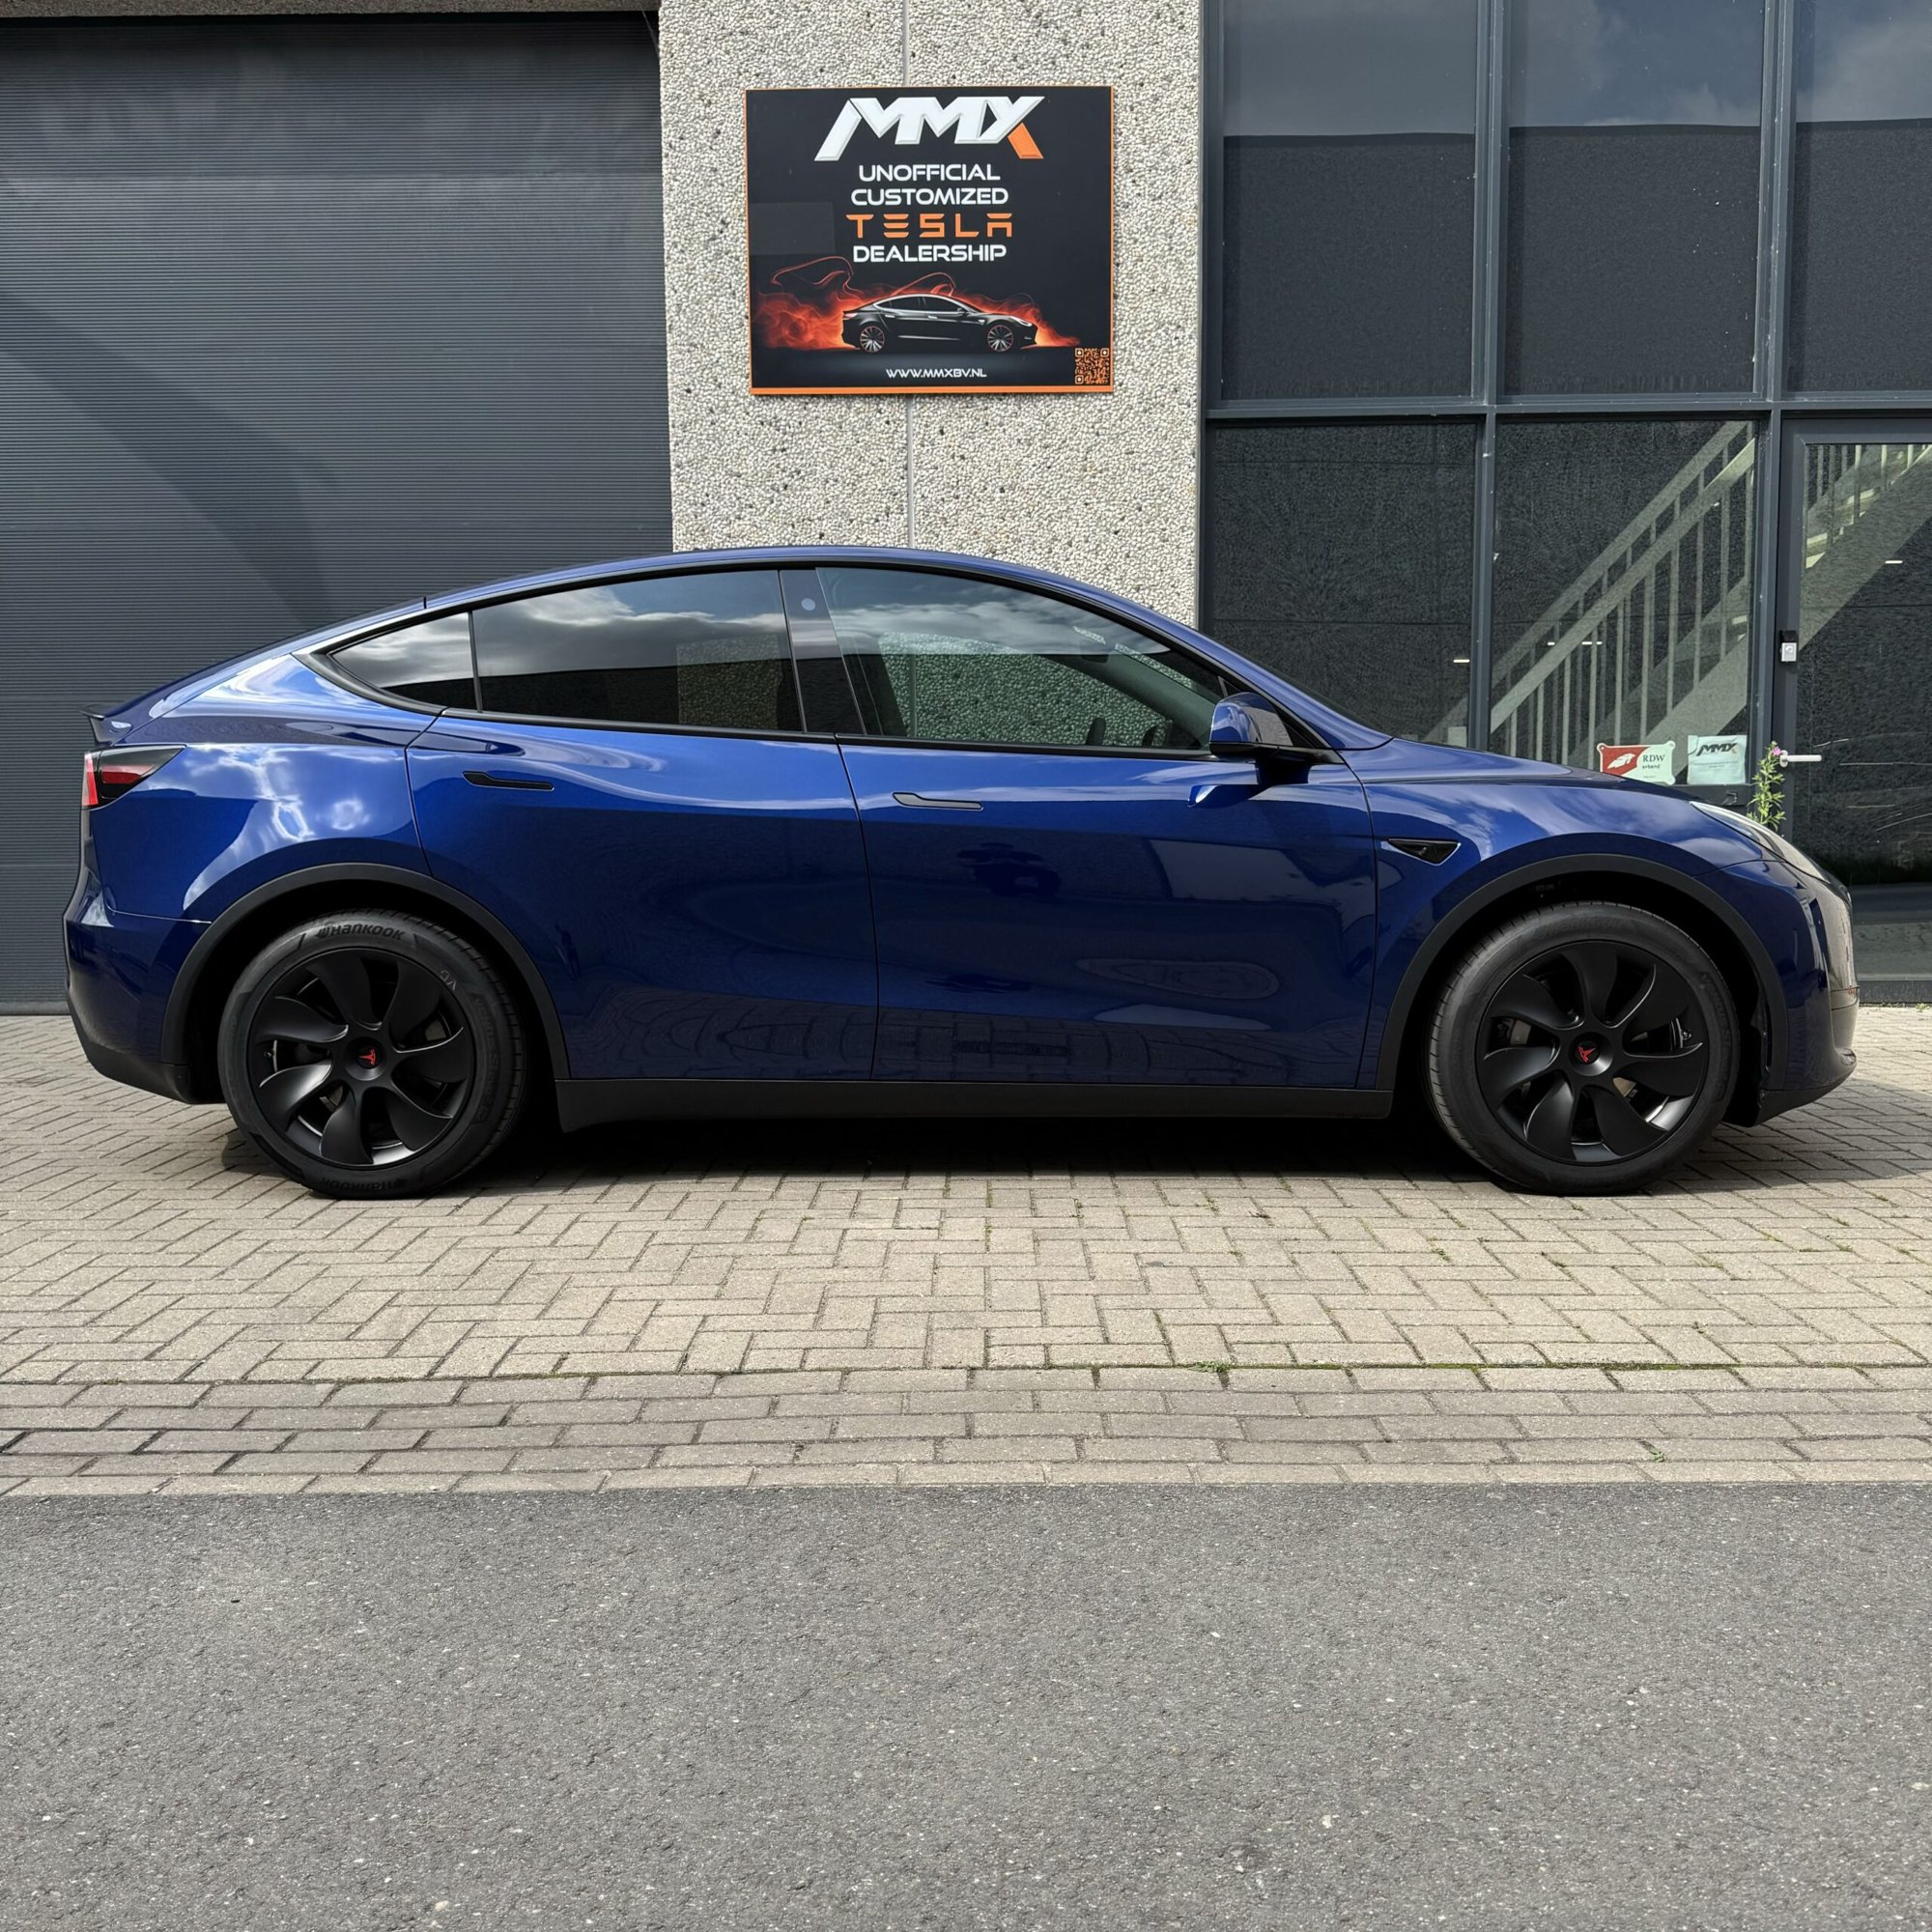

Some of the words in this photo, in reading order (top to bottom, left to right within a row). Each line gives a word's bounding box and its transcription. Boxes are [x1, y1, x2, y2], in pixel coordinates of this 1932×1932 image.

[813, 96, 1045, 162] MMX
[858, 163, 1002, 183] UNOFFICIAL
[850, 186, 1009, 207] CUSTOMIZED
[845, 213, 1013, 239] TESLA
[852, 243, 1008, 264] DEALERSHIP
[885, 367, 988, 380] WWW.MMXBV.NL
[1643, 754, 1665, 763] RDW
